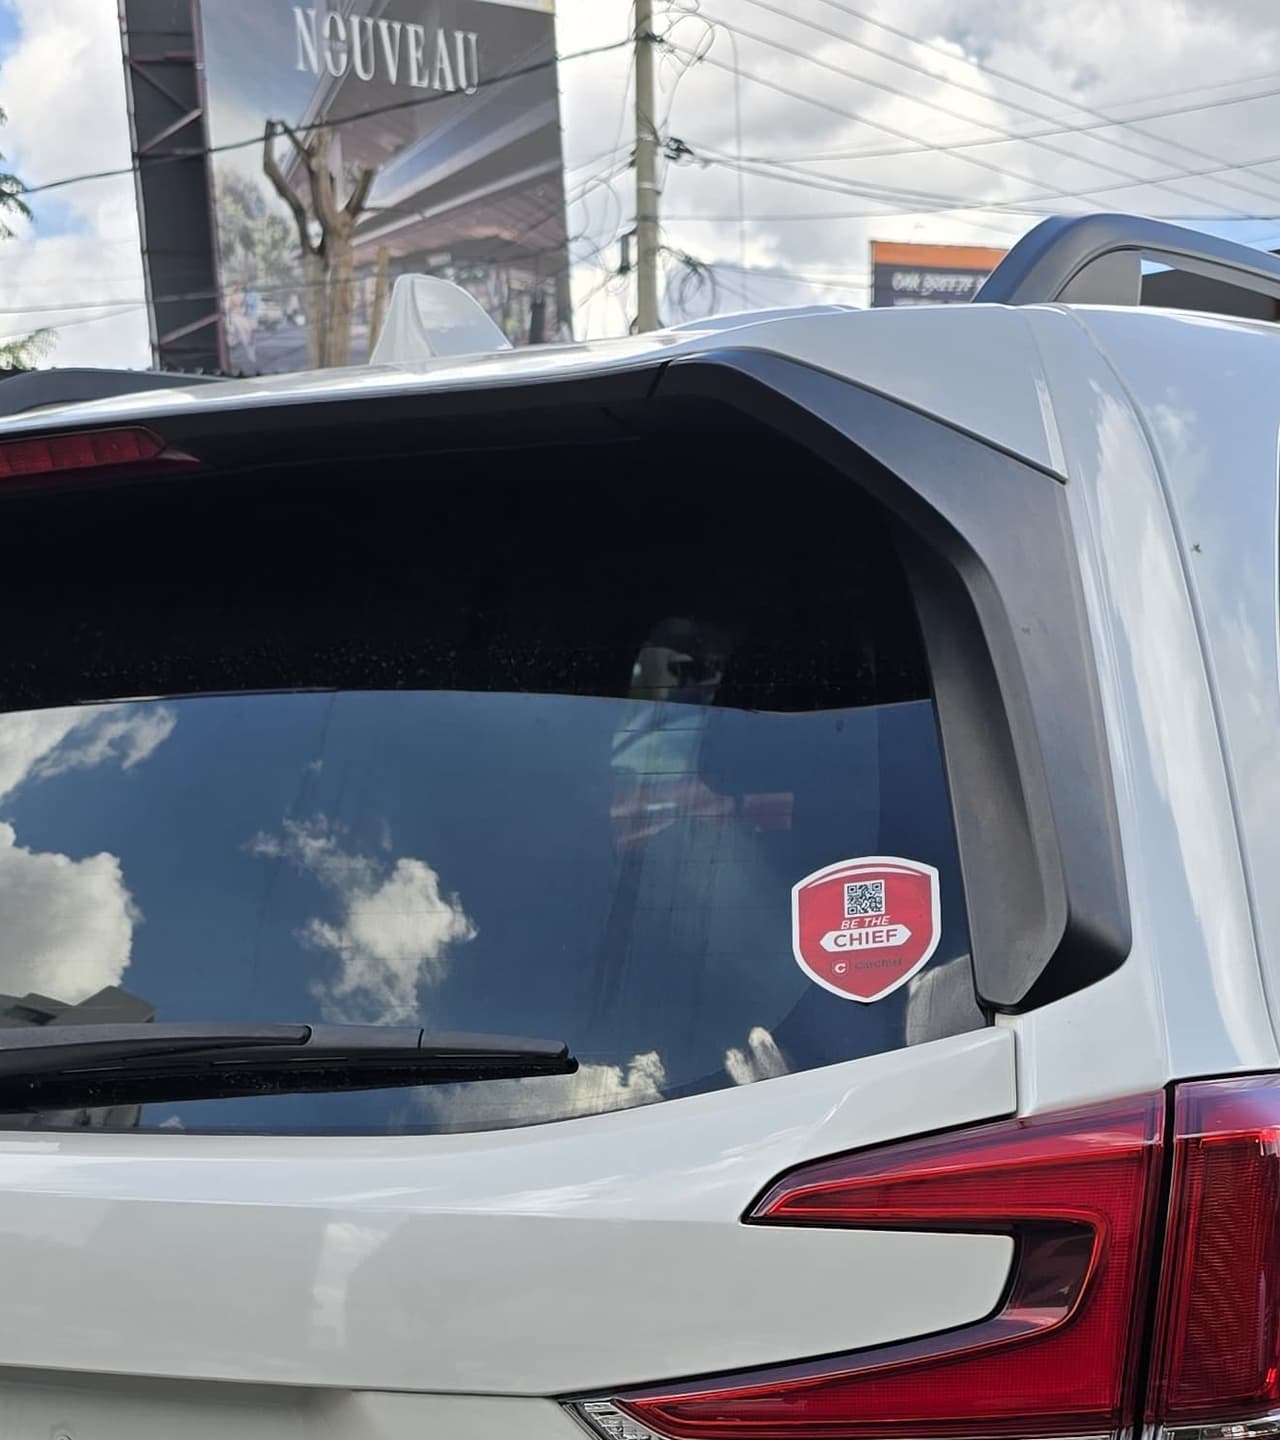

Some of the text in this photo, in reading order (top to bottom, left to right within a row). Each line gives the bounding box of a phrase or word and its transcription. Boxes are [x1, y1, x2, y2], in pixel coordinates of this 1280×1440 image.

[293, 6, 479, 95] NOUVEAU
[841, 915, 891, 930] BE THE
[833, 929, 898, 948] CHIEF
